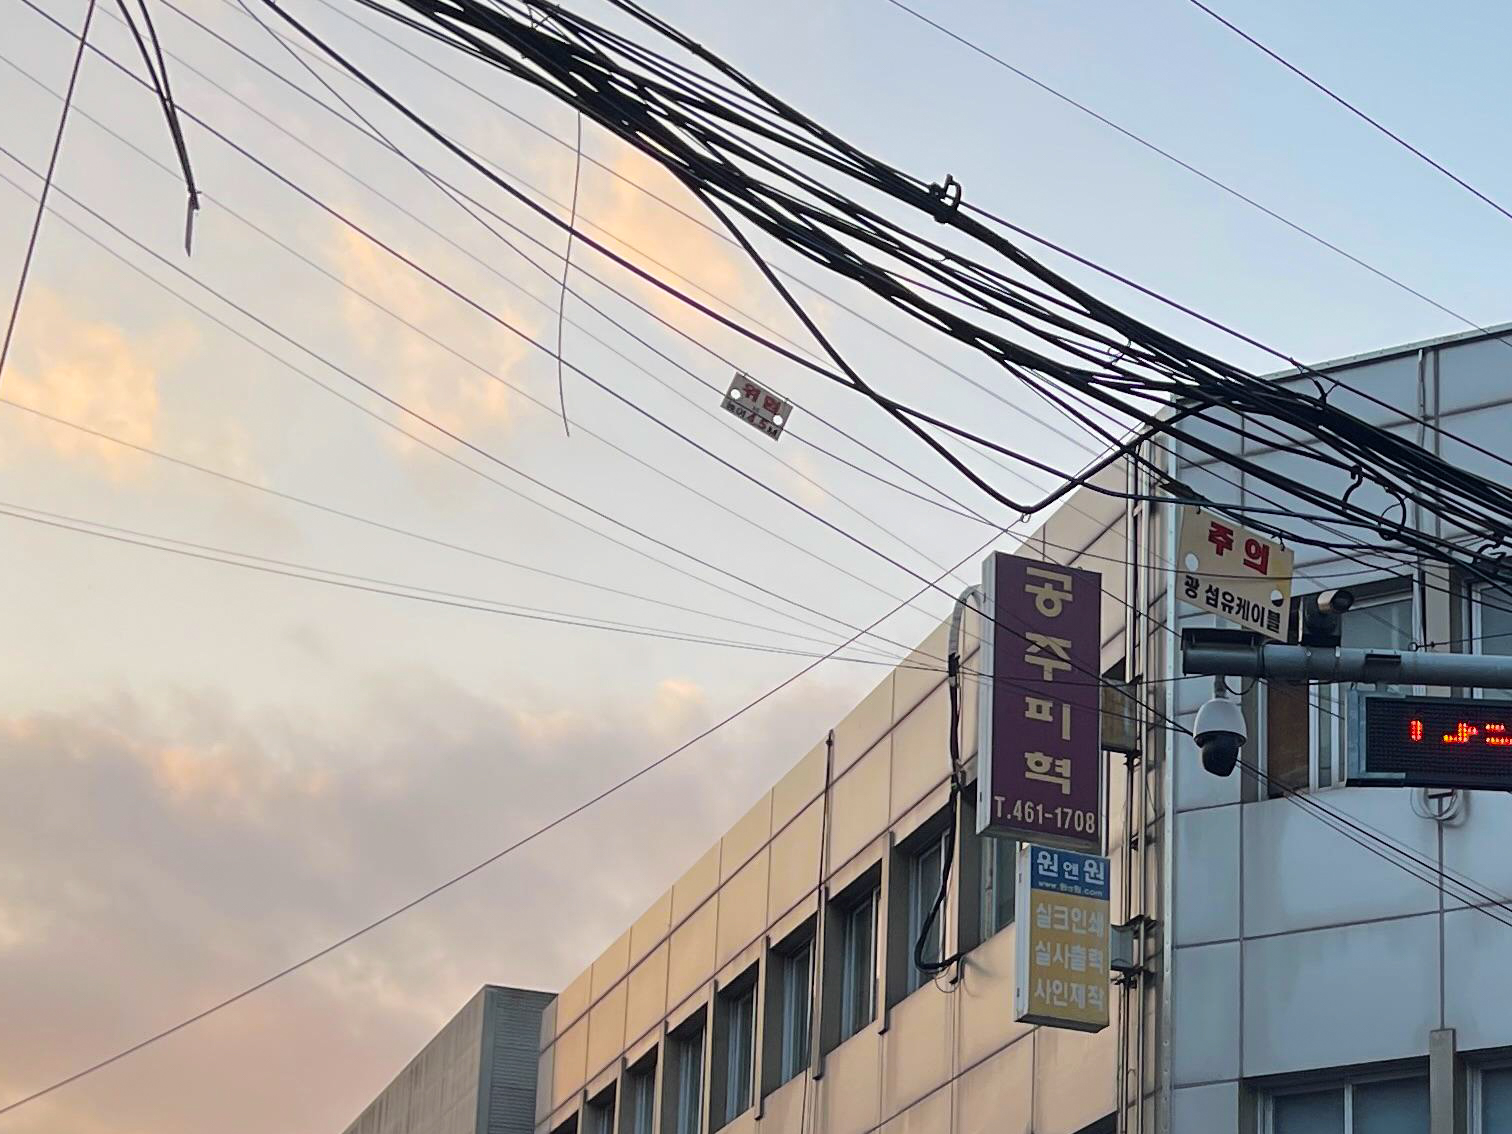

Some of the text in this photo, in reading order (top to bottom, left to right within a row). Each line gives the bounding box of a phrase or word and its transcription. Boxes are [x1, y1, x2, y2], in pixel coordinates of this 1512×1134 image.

[1208, 521, 1270, 576] 주의
[1025, 566, 1073, 795] 공주피혁
[994, 796, 1095, 834] T.461-1708
[1036, 902, 1104, 937] 실크인쇄
[1035, 940, 1103, 974] 실사출력
[1034, 978, 1105, 1012] 사인제작
